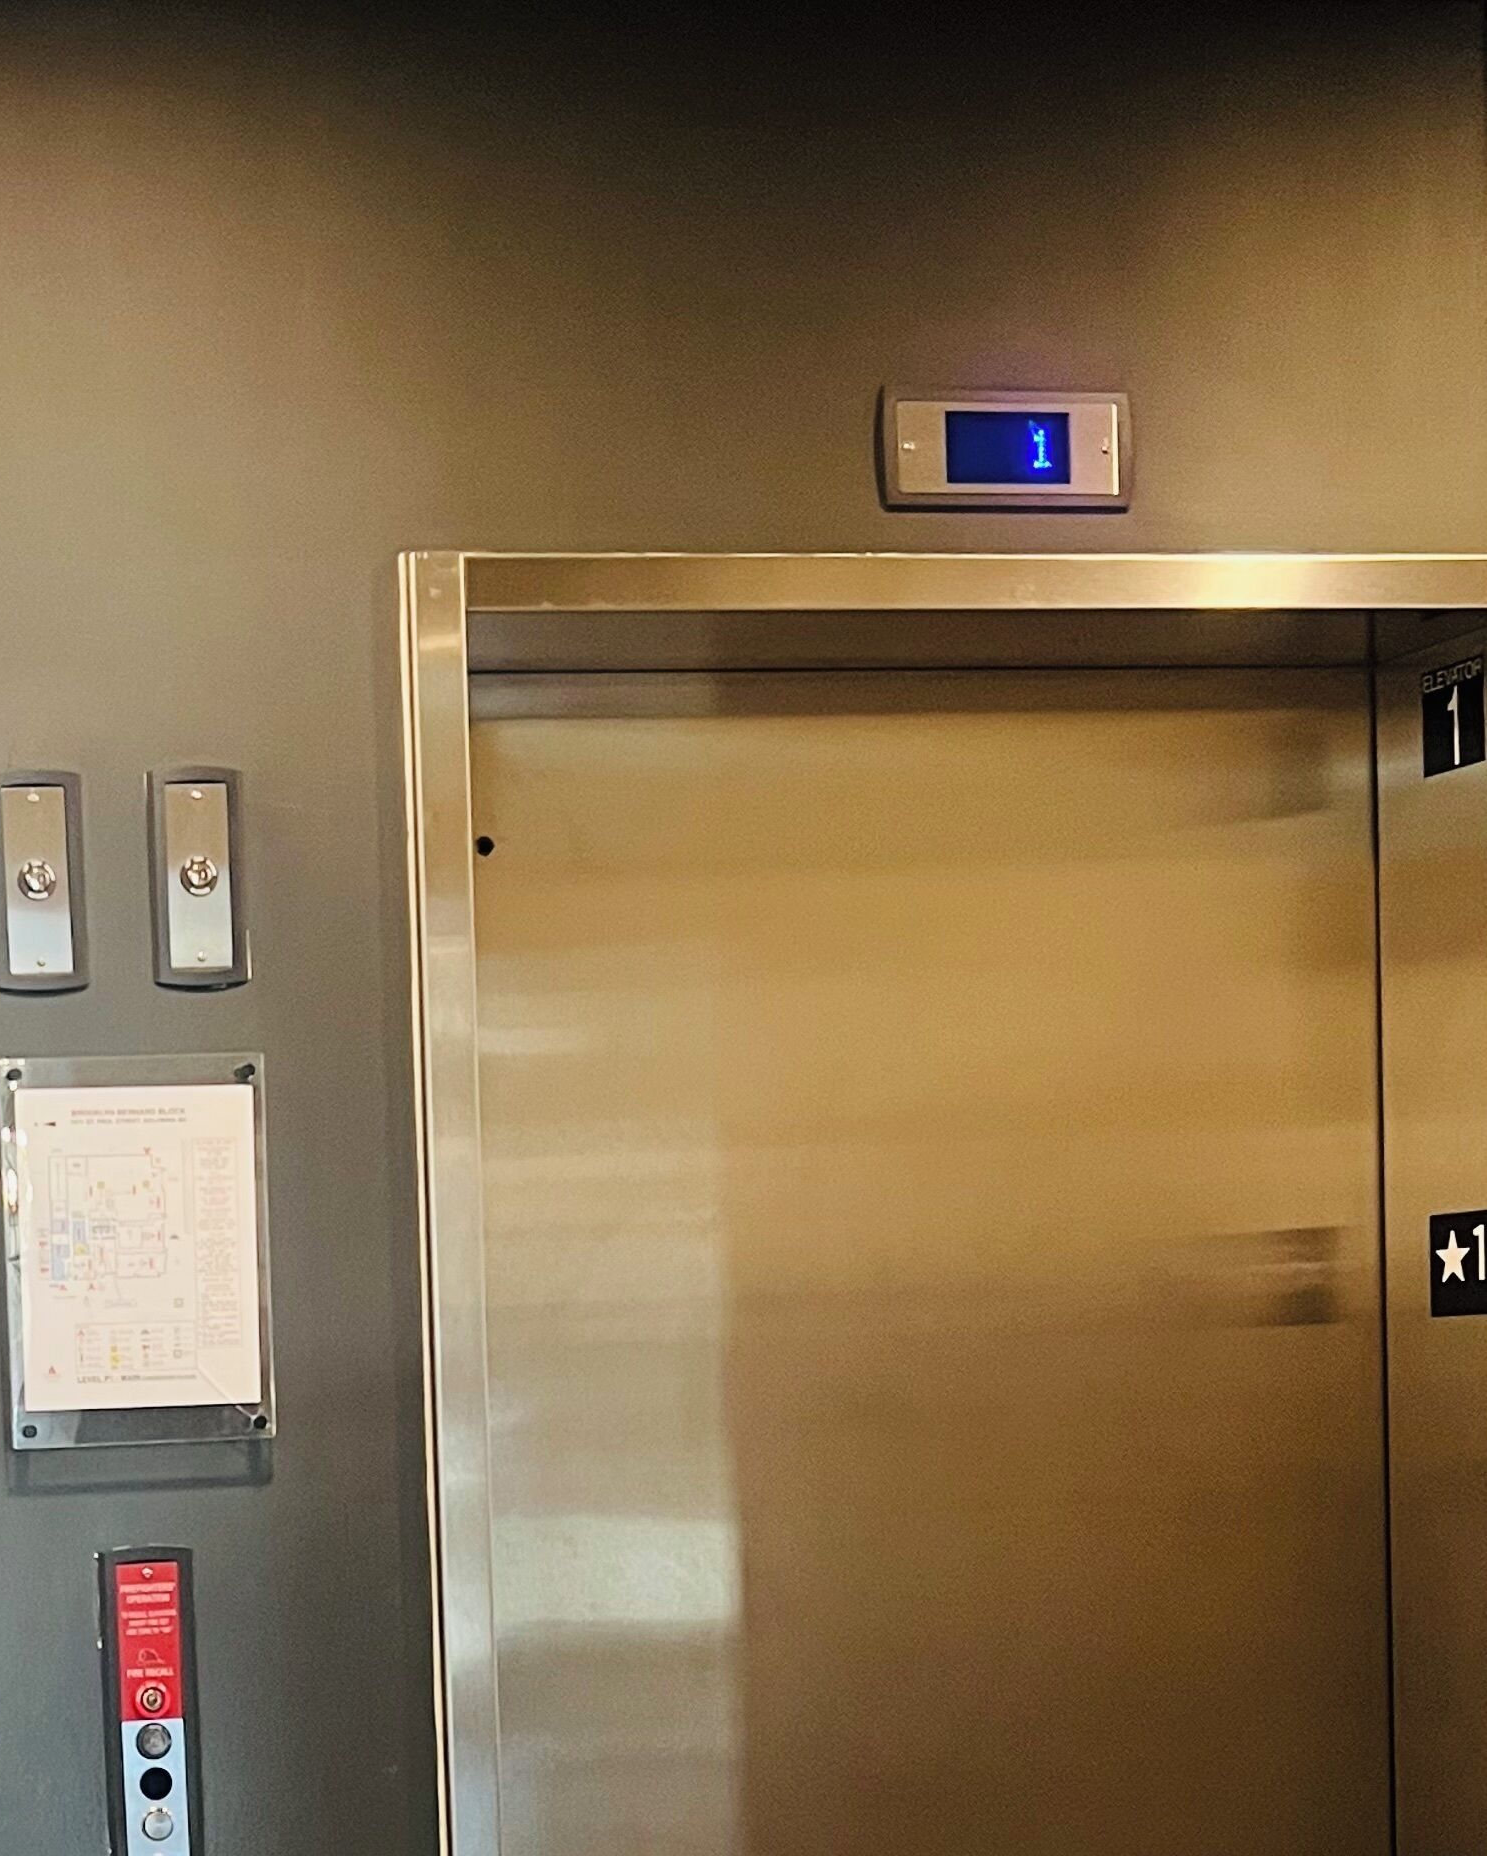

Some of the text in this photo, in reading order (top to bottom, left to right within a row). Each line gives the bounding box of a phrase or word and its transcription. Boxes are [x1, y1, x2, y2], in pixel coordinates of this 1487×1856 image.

[1032, 428, 1053, 469] 1
[1447, 684, 1460, 765] 1
[1472, 1223, 1486, 1281] 1
